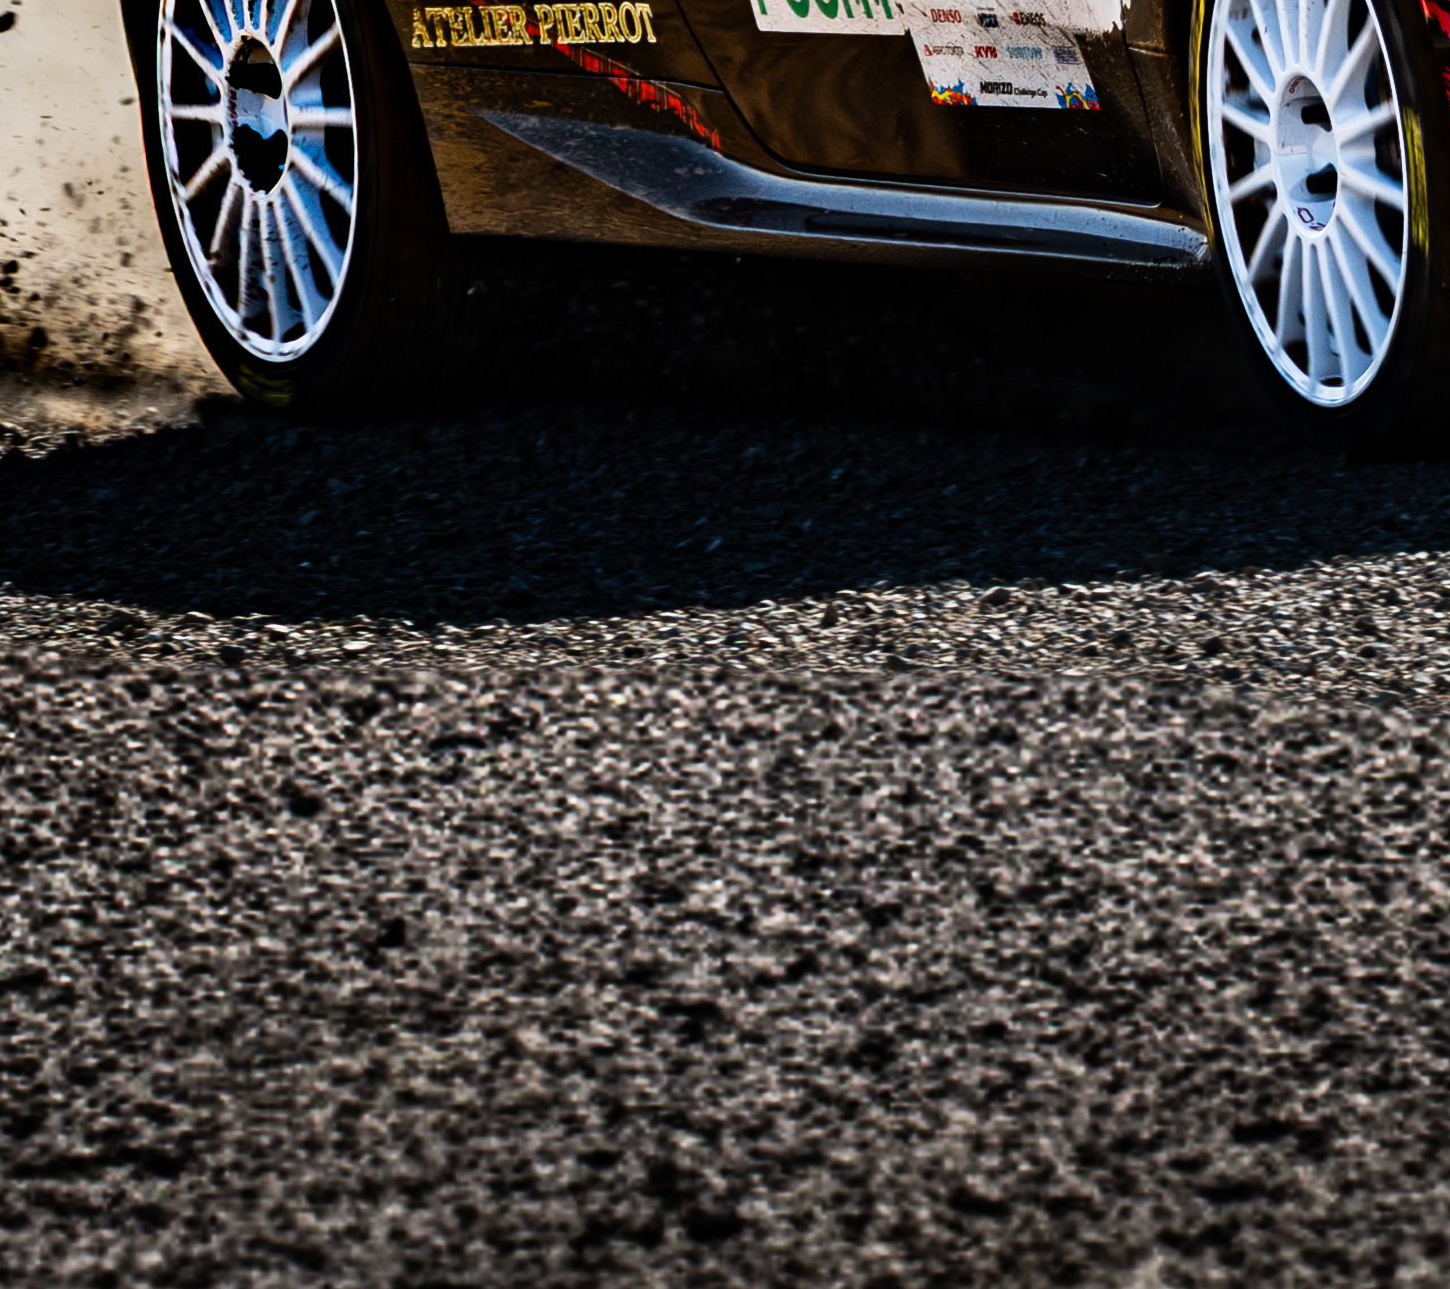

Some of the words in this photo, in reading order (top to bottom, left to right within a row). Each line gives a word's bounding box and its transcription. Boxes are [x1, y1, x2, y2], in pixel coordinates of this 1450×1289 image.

[930, 8, 962, 23] DENSO
[1019, 11, 1047, 27] ENEOS
[412, 5, 533, 49] ATELIER
[534, 1, 657, 45] PIERROT
[979, 81, 1013, 95] MORIZO
